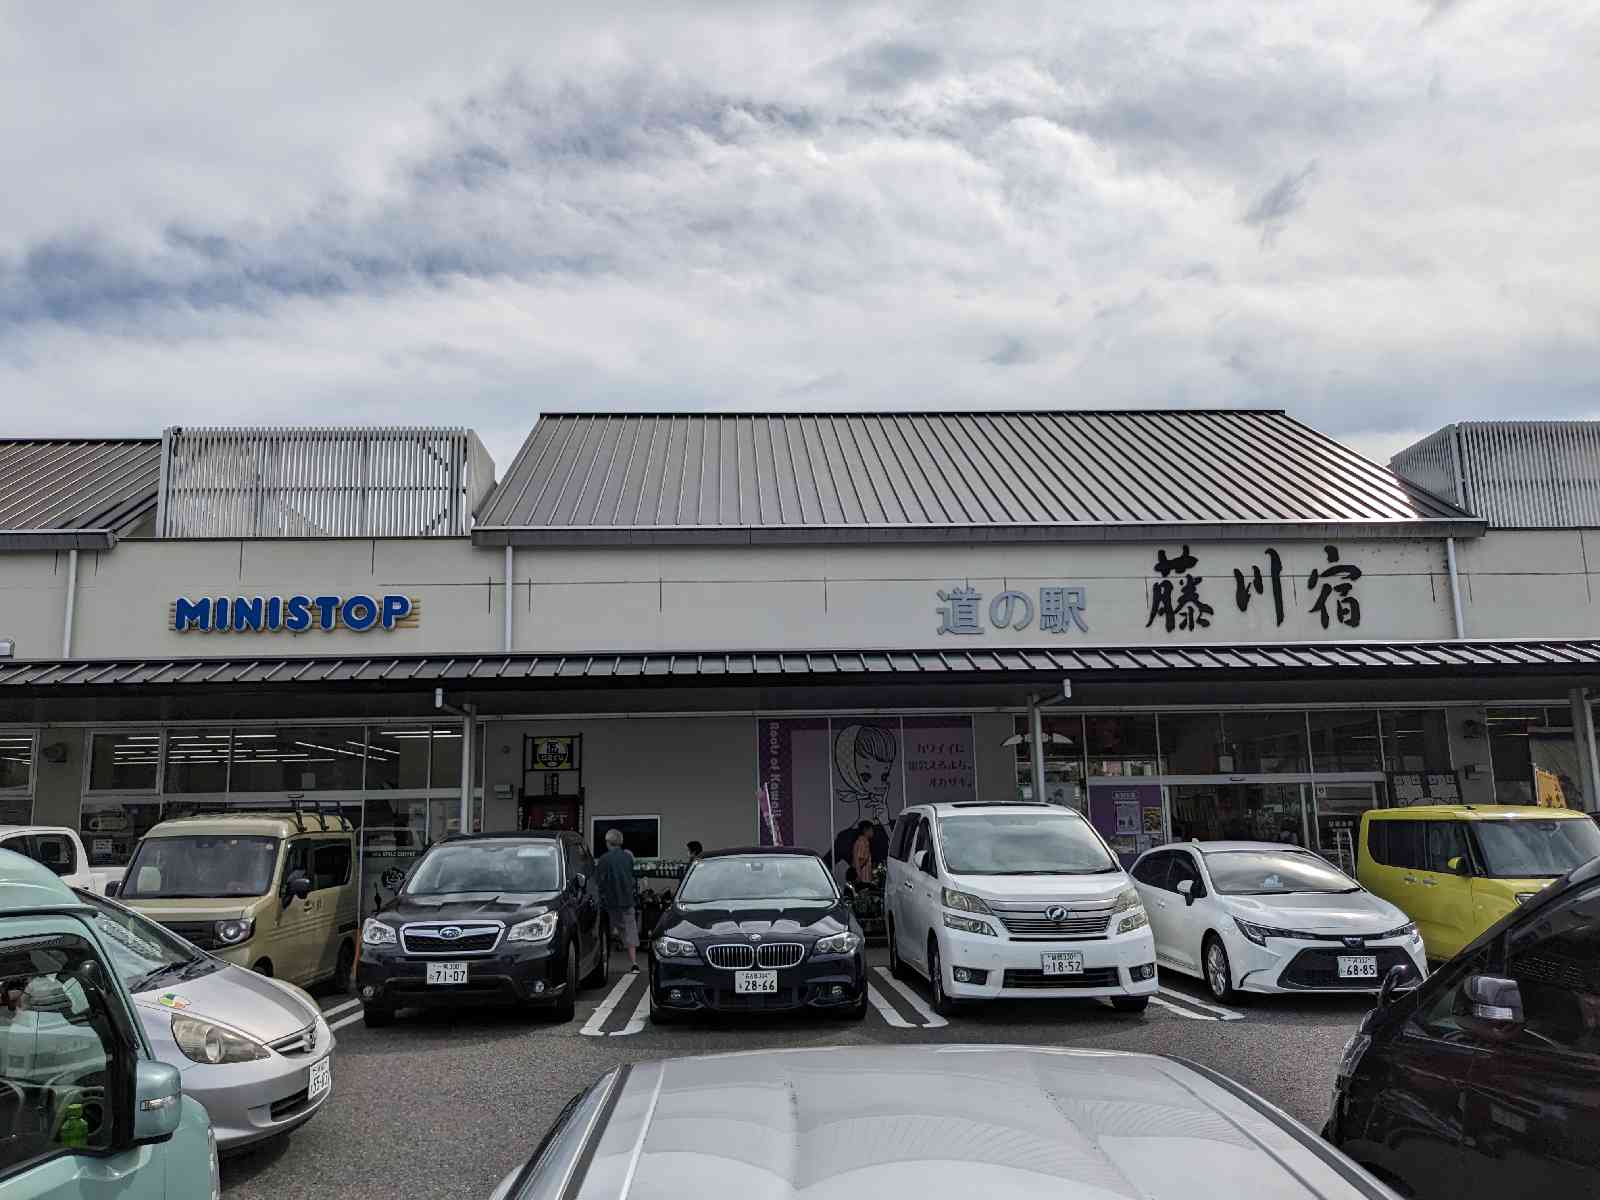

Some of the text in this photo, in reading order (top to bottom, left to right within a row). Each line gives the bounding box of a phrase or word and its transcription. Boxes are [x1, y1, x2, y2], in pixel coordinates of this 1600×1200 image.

[1145, 545, 1361, 631] 藤川宿
[176, 595, 412, 632] MINISTOP
[936, 586, 1088, 635] 道の駅
[435, 970, 466, 982] 71-07
[1346, 964, 1376, 976] 68-85
[744, 980, 775, 991] 28-66
